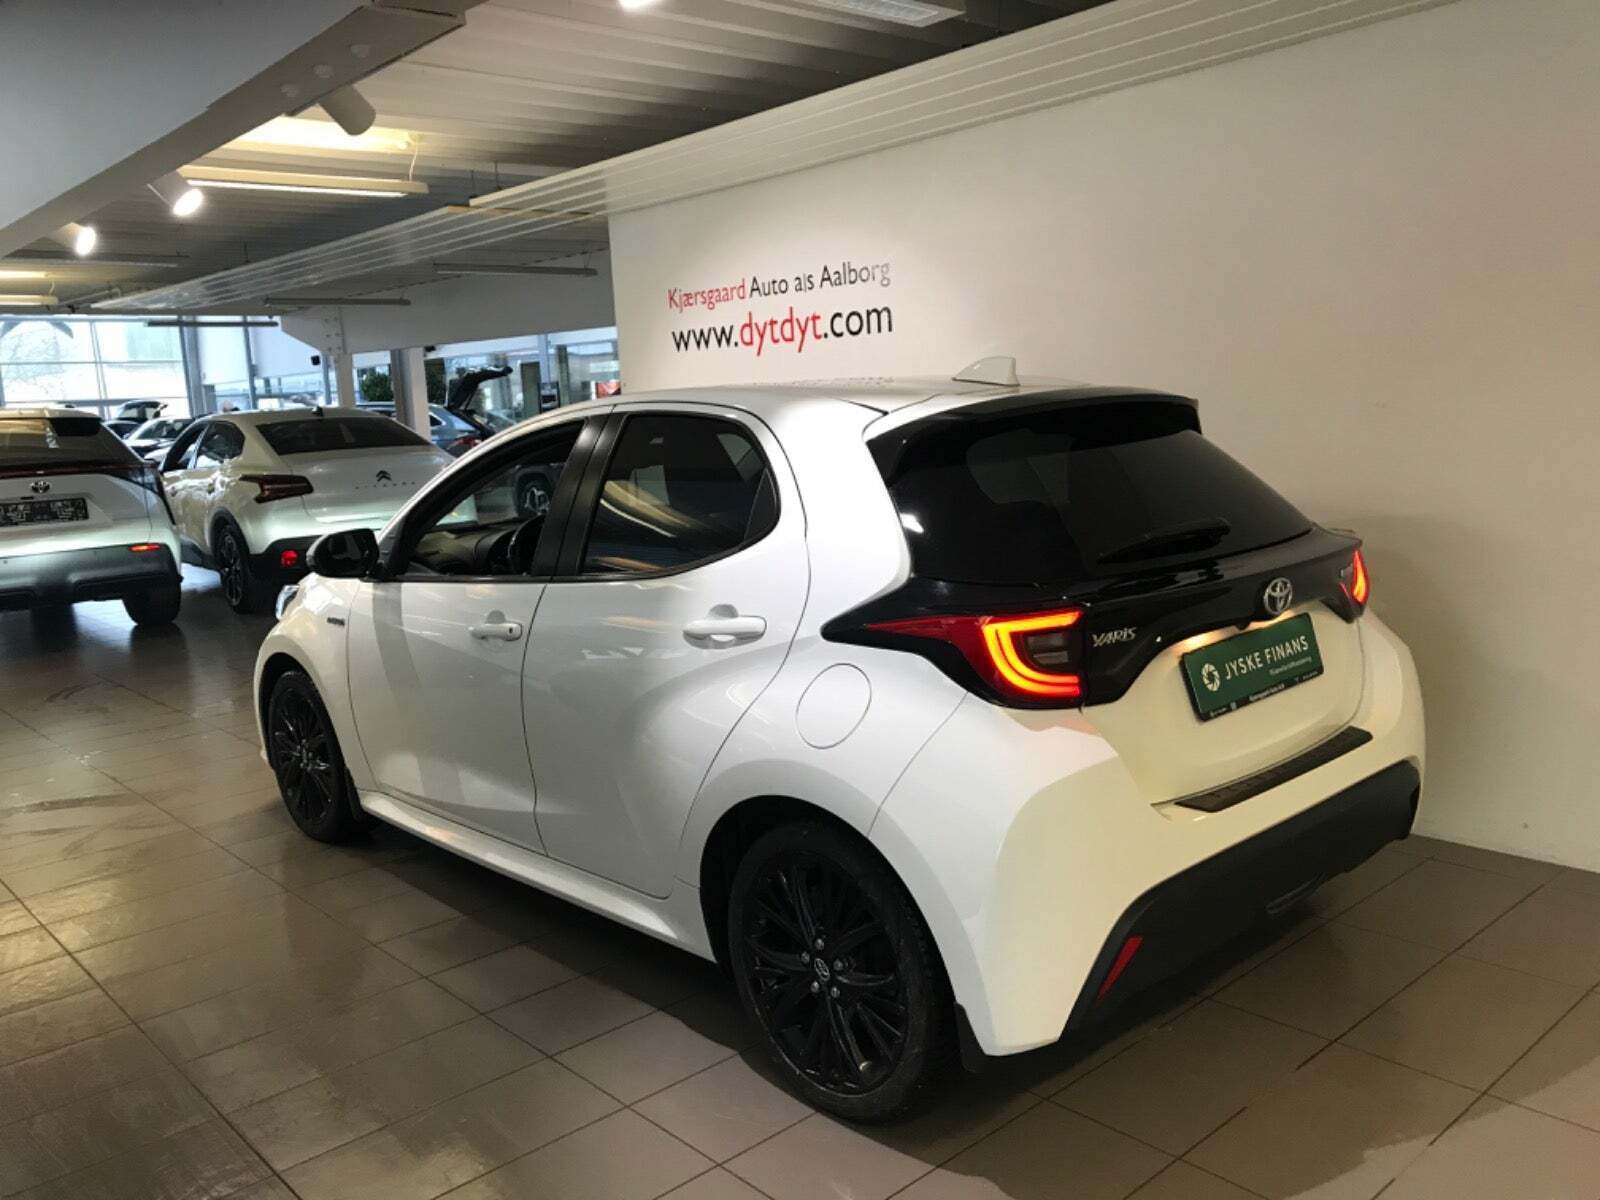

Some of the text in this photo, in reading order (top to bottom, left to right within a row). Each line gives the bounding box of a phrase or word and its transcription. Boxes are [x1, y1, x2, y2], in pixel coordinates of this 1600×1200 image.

[667, 278, 747, 313] Kjærsgaard
[749, 276, 788, 298] Auto
[819, 261, 891, 288] Aalborg
[671, 305, 893, 356] www.dytdyt.com
[1225, 652, 1263, 680] JYSKE
[1265, 635, 1309, 664] FINANS
